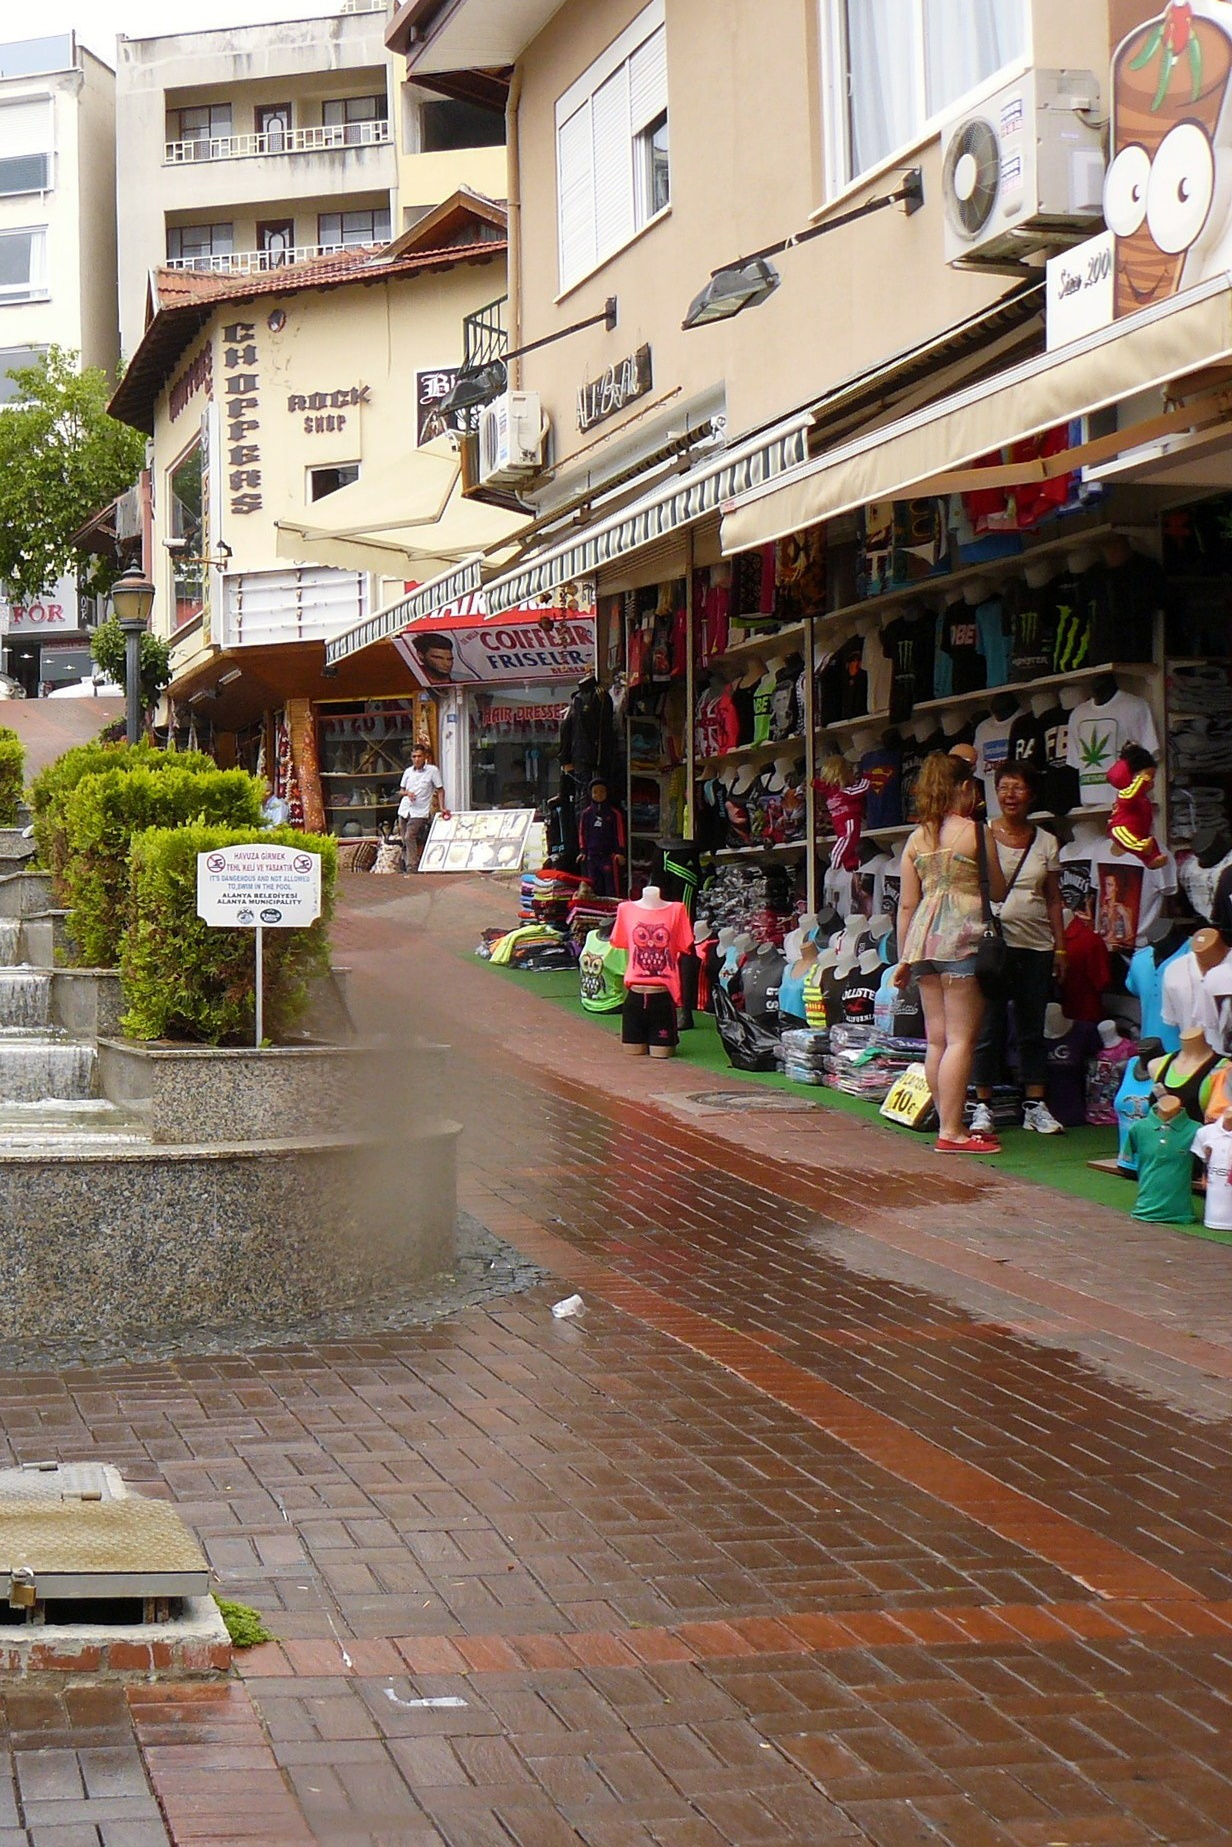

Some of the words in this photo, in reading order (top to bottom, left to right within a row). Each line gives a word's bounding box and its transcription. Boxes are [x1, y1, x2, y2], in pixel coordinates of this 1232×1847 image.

[287, 384, 372, 414] ROCK
[221, 321, 263, 515] CHOPPERS
[303, 414, 347, 434] SHOP
